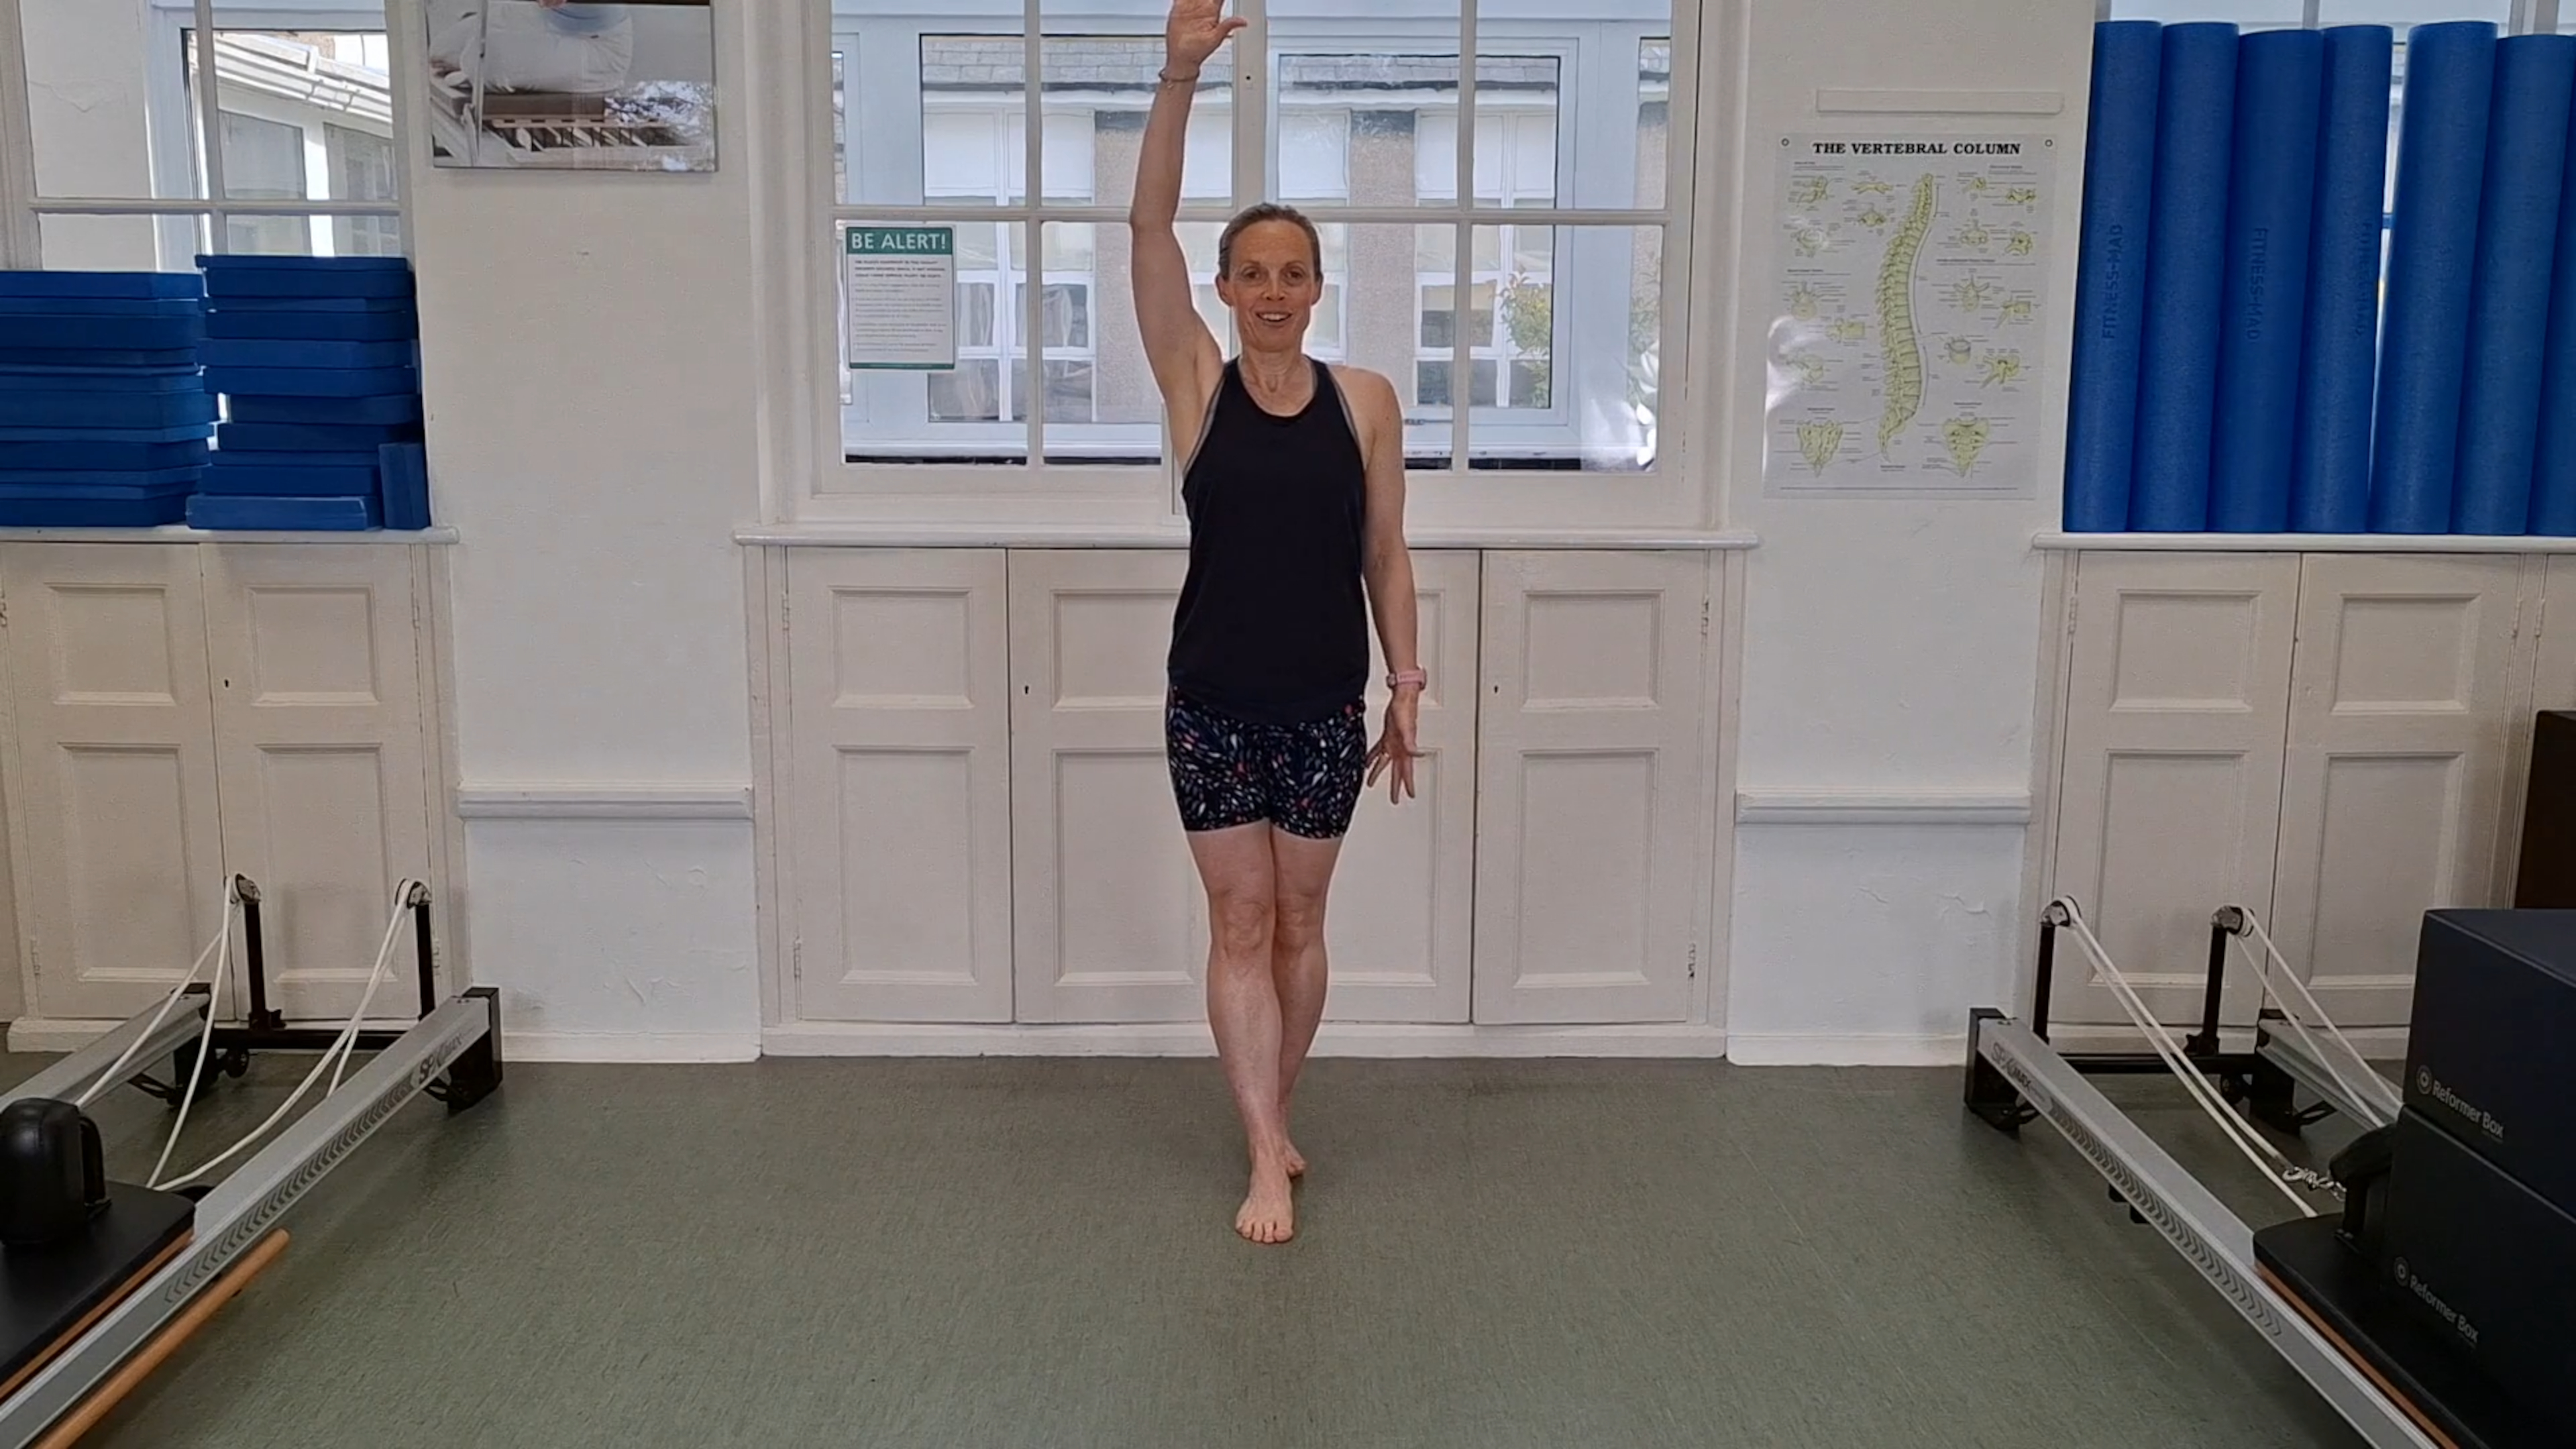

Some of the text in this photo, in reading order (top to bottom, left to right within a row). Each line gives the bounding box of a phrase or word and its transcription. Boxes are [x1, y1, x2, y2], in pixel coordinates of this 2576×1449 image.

[1813, 142, 2021, 155] THE VERTEBRAL COLUMN
[851, 233, 946, 250] BE ALERT!
[2101, 223, 2123, 339] FITNESS-MAD
[2245, 227, 2269, 340] FITNESS-MAD
[2432, 1079, 2482, 1124] Reformer
[2482, 1111, 2504, 1138] Box
[2410, 1273, 2459, 1323] Reformer
[2457, 1313, 2479, 1344] Box
